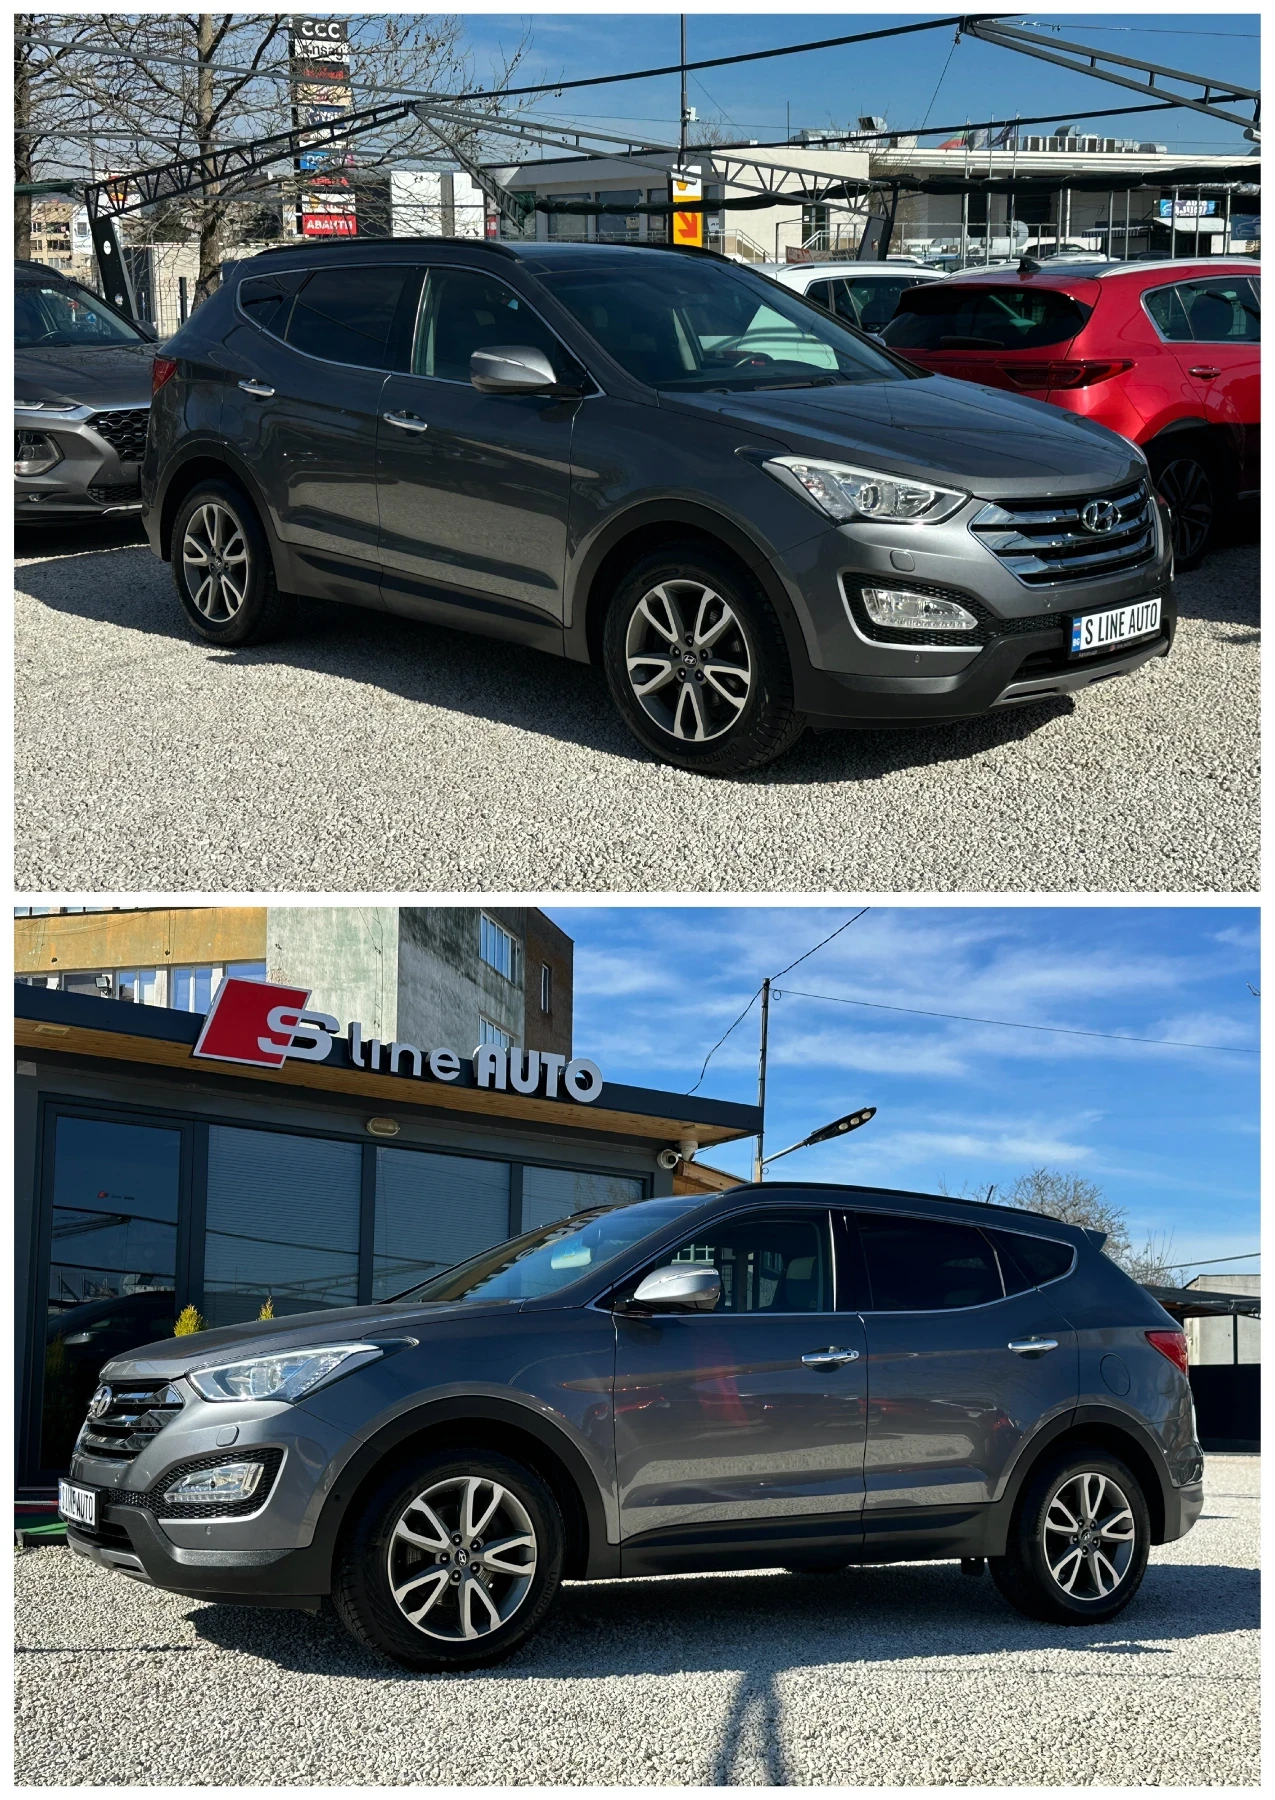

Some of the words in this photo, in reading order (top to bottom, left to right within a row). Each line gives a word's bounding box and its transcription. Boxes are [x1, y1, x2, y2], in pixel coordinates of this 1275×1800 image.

[301, 20, 340, 38] CCC
[1084, 618, 1094, 645] S
[1097, 611, 1126, 643] LINE
[1128, 602, 1158, 635] AUTO
[257, 1005, 341, 1061] S
[348, 1021, 461, 1081] line
[473, 1042, 604, 1103] AUTO
[65, 1486, 76, 1514] LINE
[76, 1491, 93, 1521] AUTO
[518, 1571, 559, 1633] UNIROYAL
